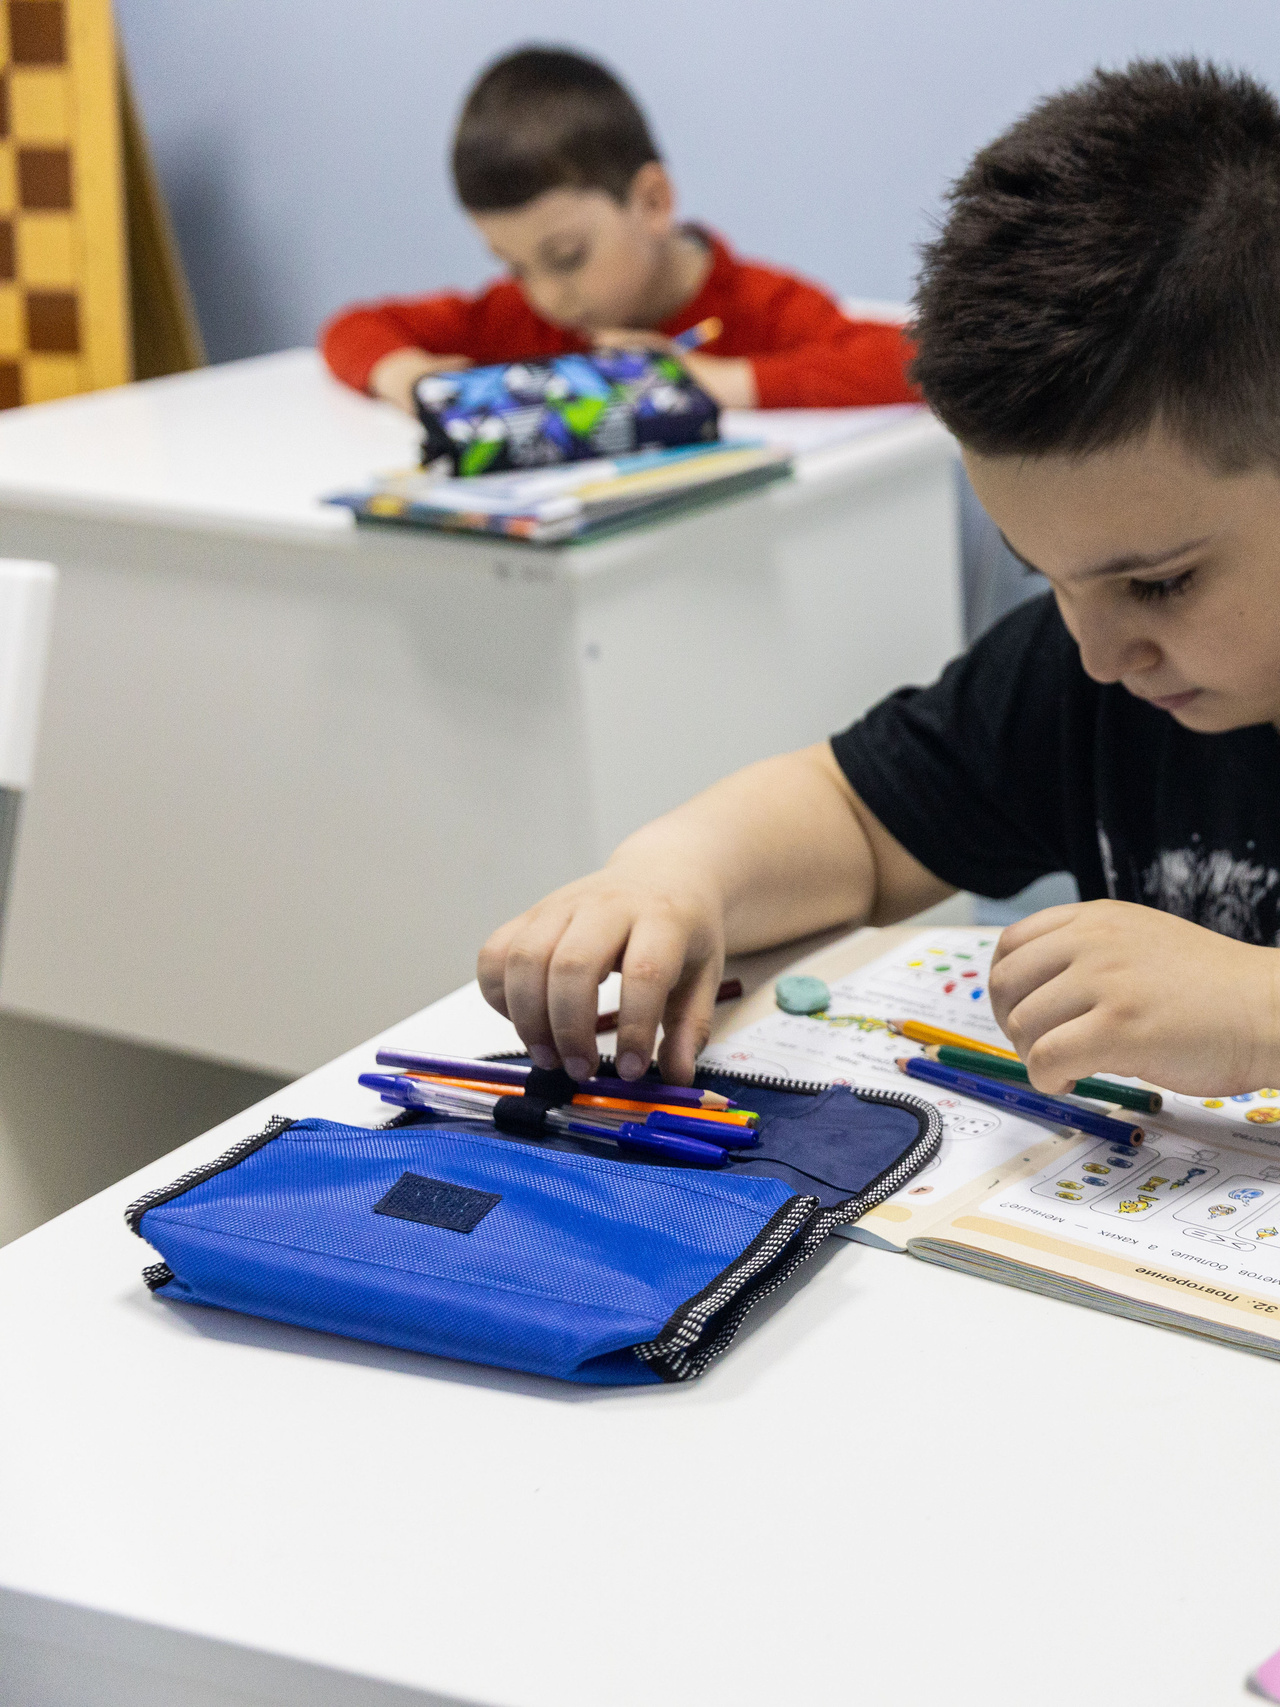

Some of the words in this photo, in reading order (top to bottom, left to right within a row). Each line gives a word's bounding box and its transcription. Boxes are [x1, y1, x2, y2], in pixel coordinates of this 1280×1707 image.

[999, 1201, 1066, 1223] меньше?
[1098, 1230, 1139, 1245] каких
[1170, 1249, 1229, 1271] больше,
[1135, 1267, 1240, 1303] Повторение
[1252, 1300, 1279, 1314] 32.
